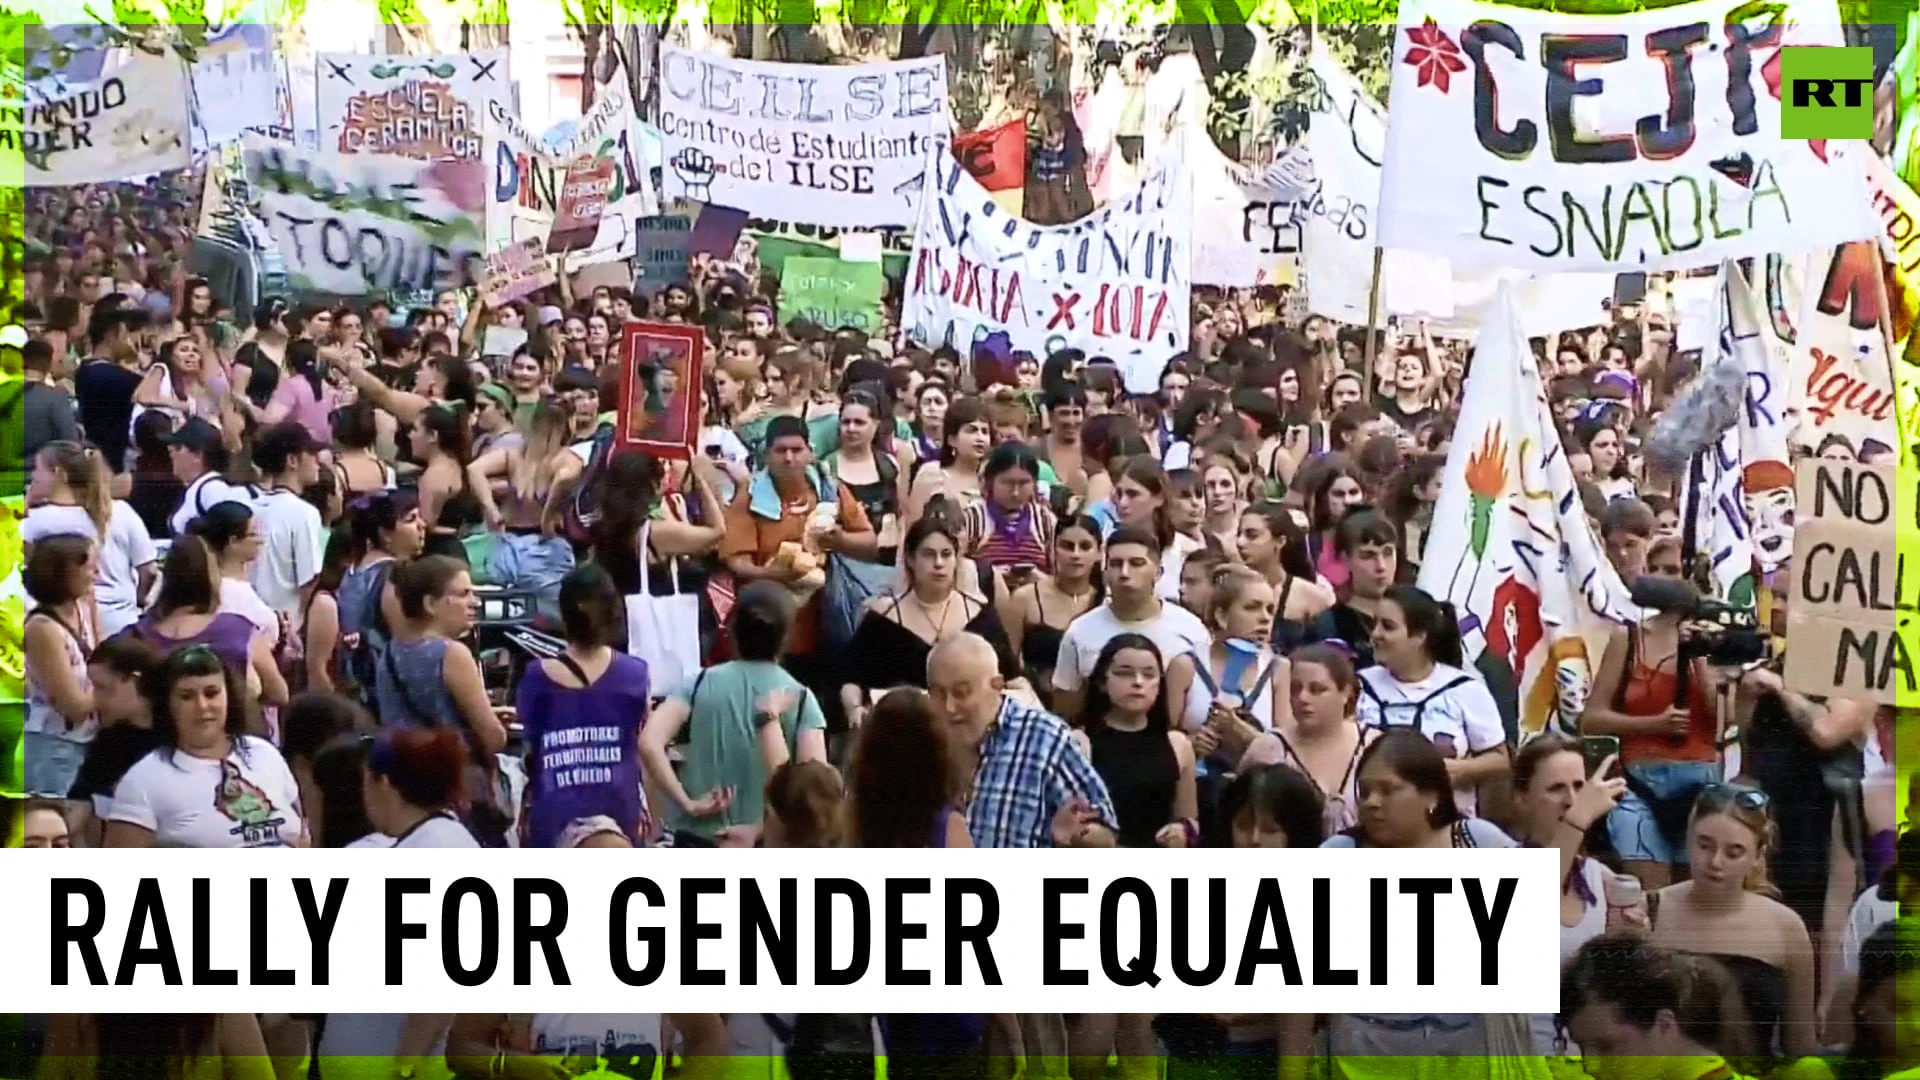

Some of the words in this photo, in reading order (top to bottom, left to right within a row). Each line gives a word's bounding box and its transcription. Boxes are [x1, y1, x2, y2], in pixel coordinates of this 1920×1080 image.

[662, 111, 745, 149] Centro
[749, 127, 781, 154] de
[729, 154, 774, 182] del
[787, 160, 875, 195] ILSE
[1477, 158, 1791, 262] ESNAOLA
[1814, 465, 1890, 525] NO
[1802, 542, 1920, 611] CALL
